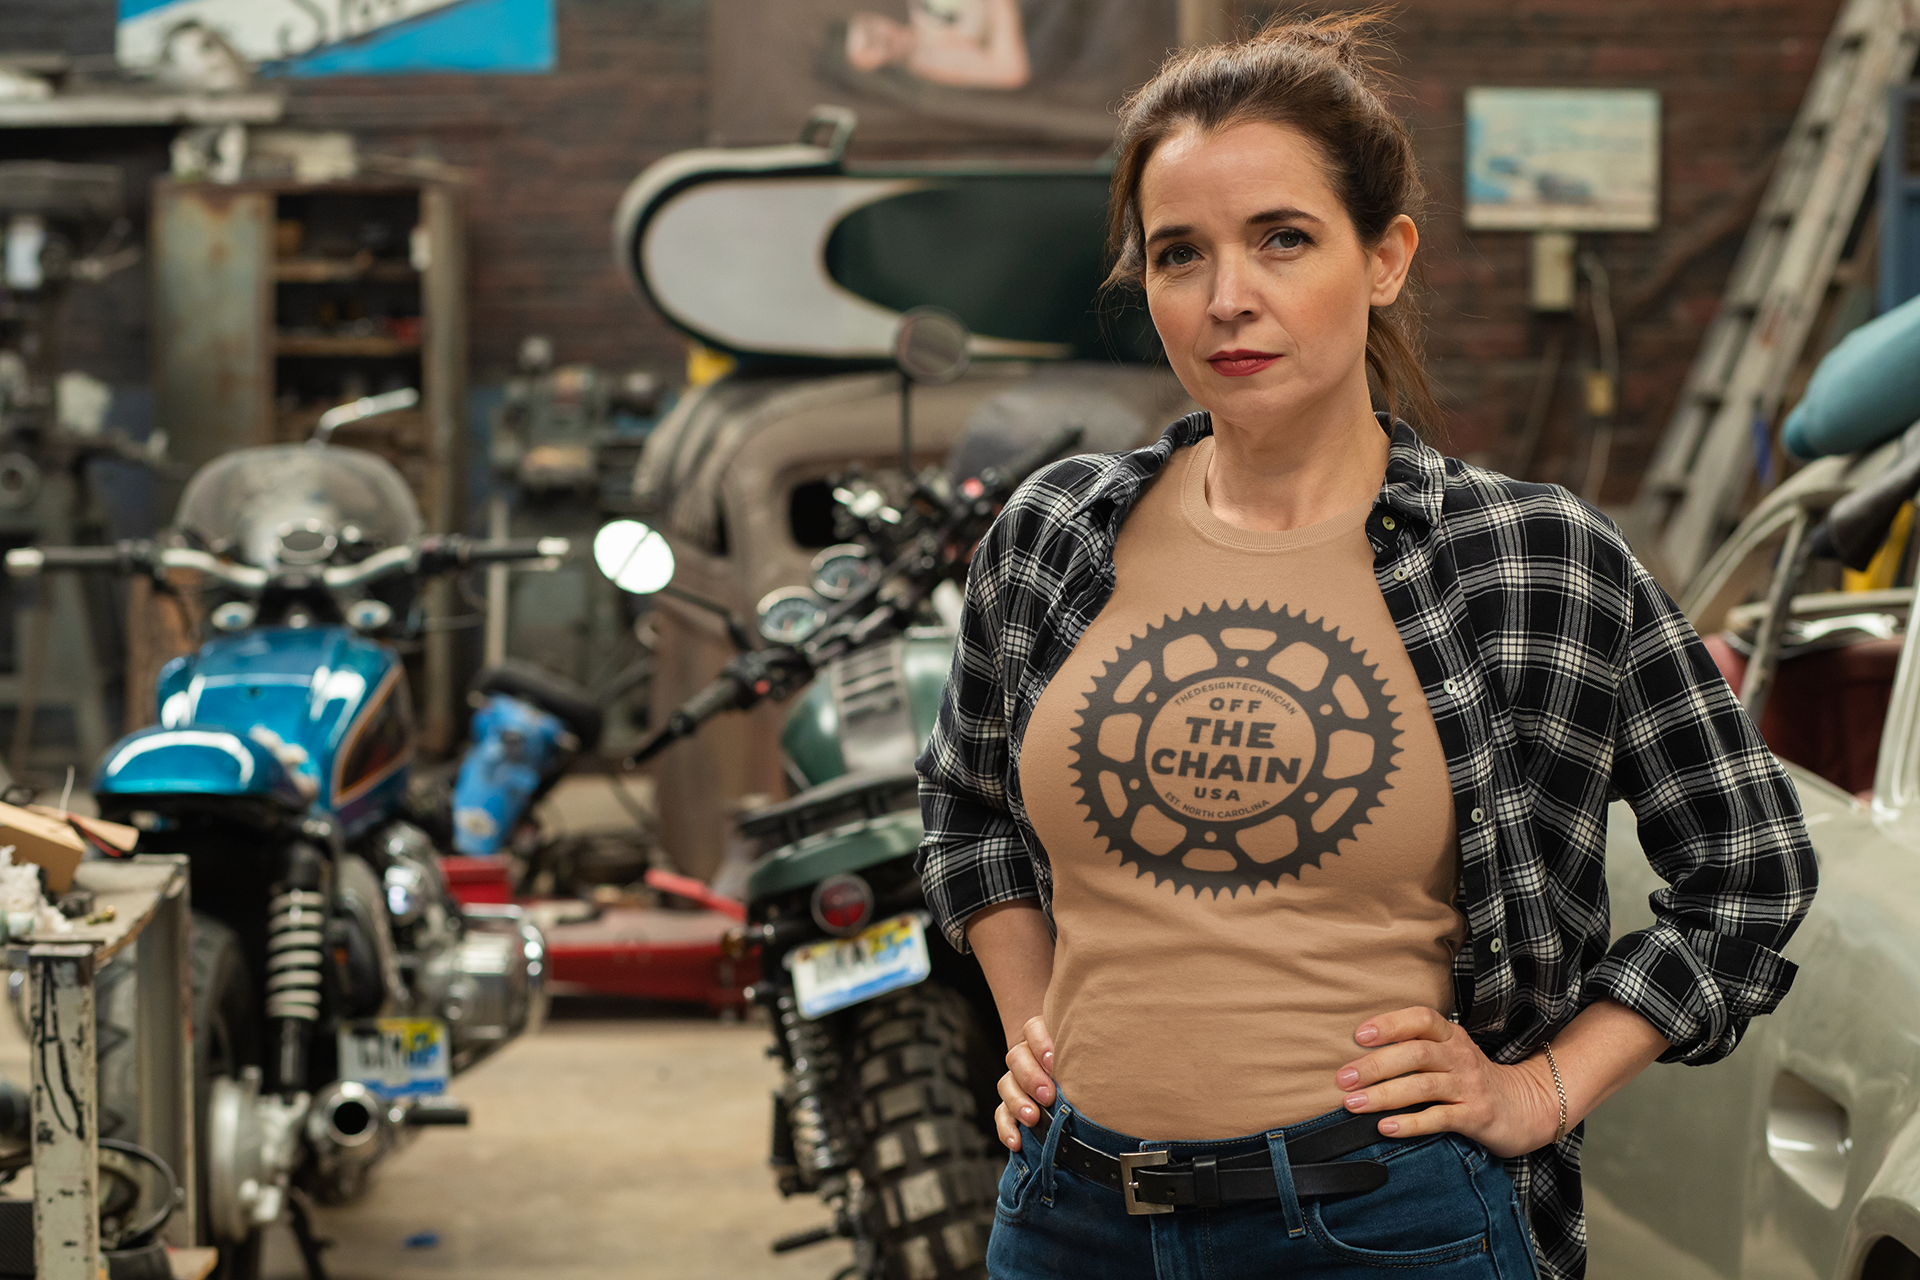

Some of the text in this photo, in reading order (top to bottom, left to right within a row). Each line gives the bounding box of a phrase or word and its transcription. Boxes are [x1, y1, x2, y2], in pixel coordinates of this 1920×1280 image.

[1175, 682, 1297, 715] THEDESIGNTECHNICIAN
[1209, 697, 1262, 713] OFF
[1186, 717, 1276, 748] THE
[1151, 748, 1301, 783] CHAIN
[1164, 791, 1270, 818] EST. NORTH CAROLINA
[1194, 787, 1240, 801] USA
